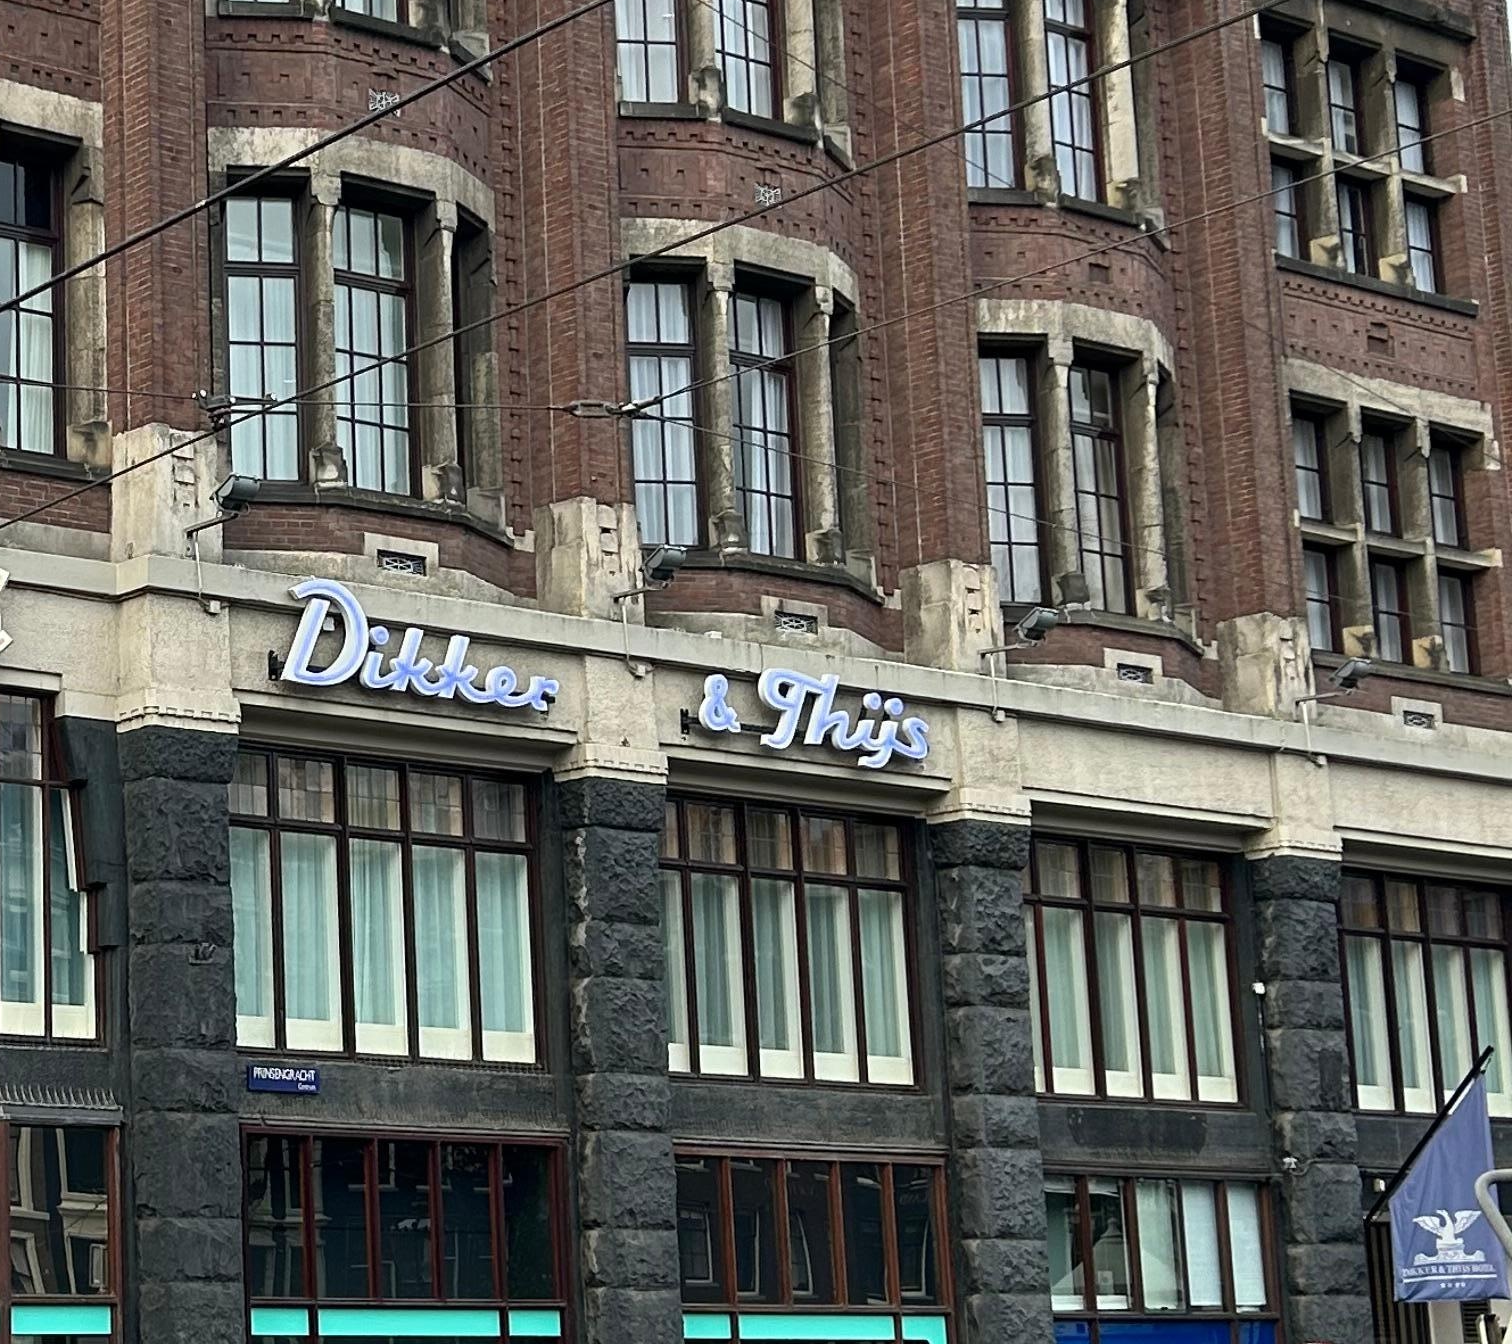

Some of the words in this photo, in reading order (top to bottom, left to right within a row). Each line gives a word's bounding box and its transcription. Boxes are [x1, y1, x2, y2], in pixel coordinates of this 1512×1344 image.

[282, 577, 560, 712] Dikker
[698, 673, 742, 733] &
[757, 666, 931, 768] Thijs
